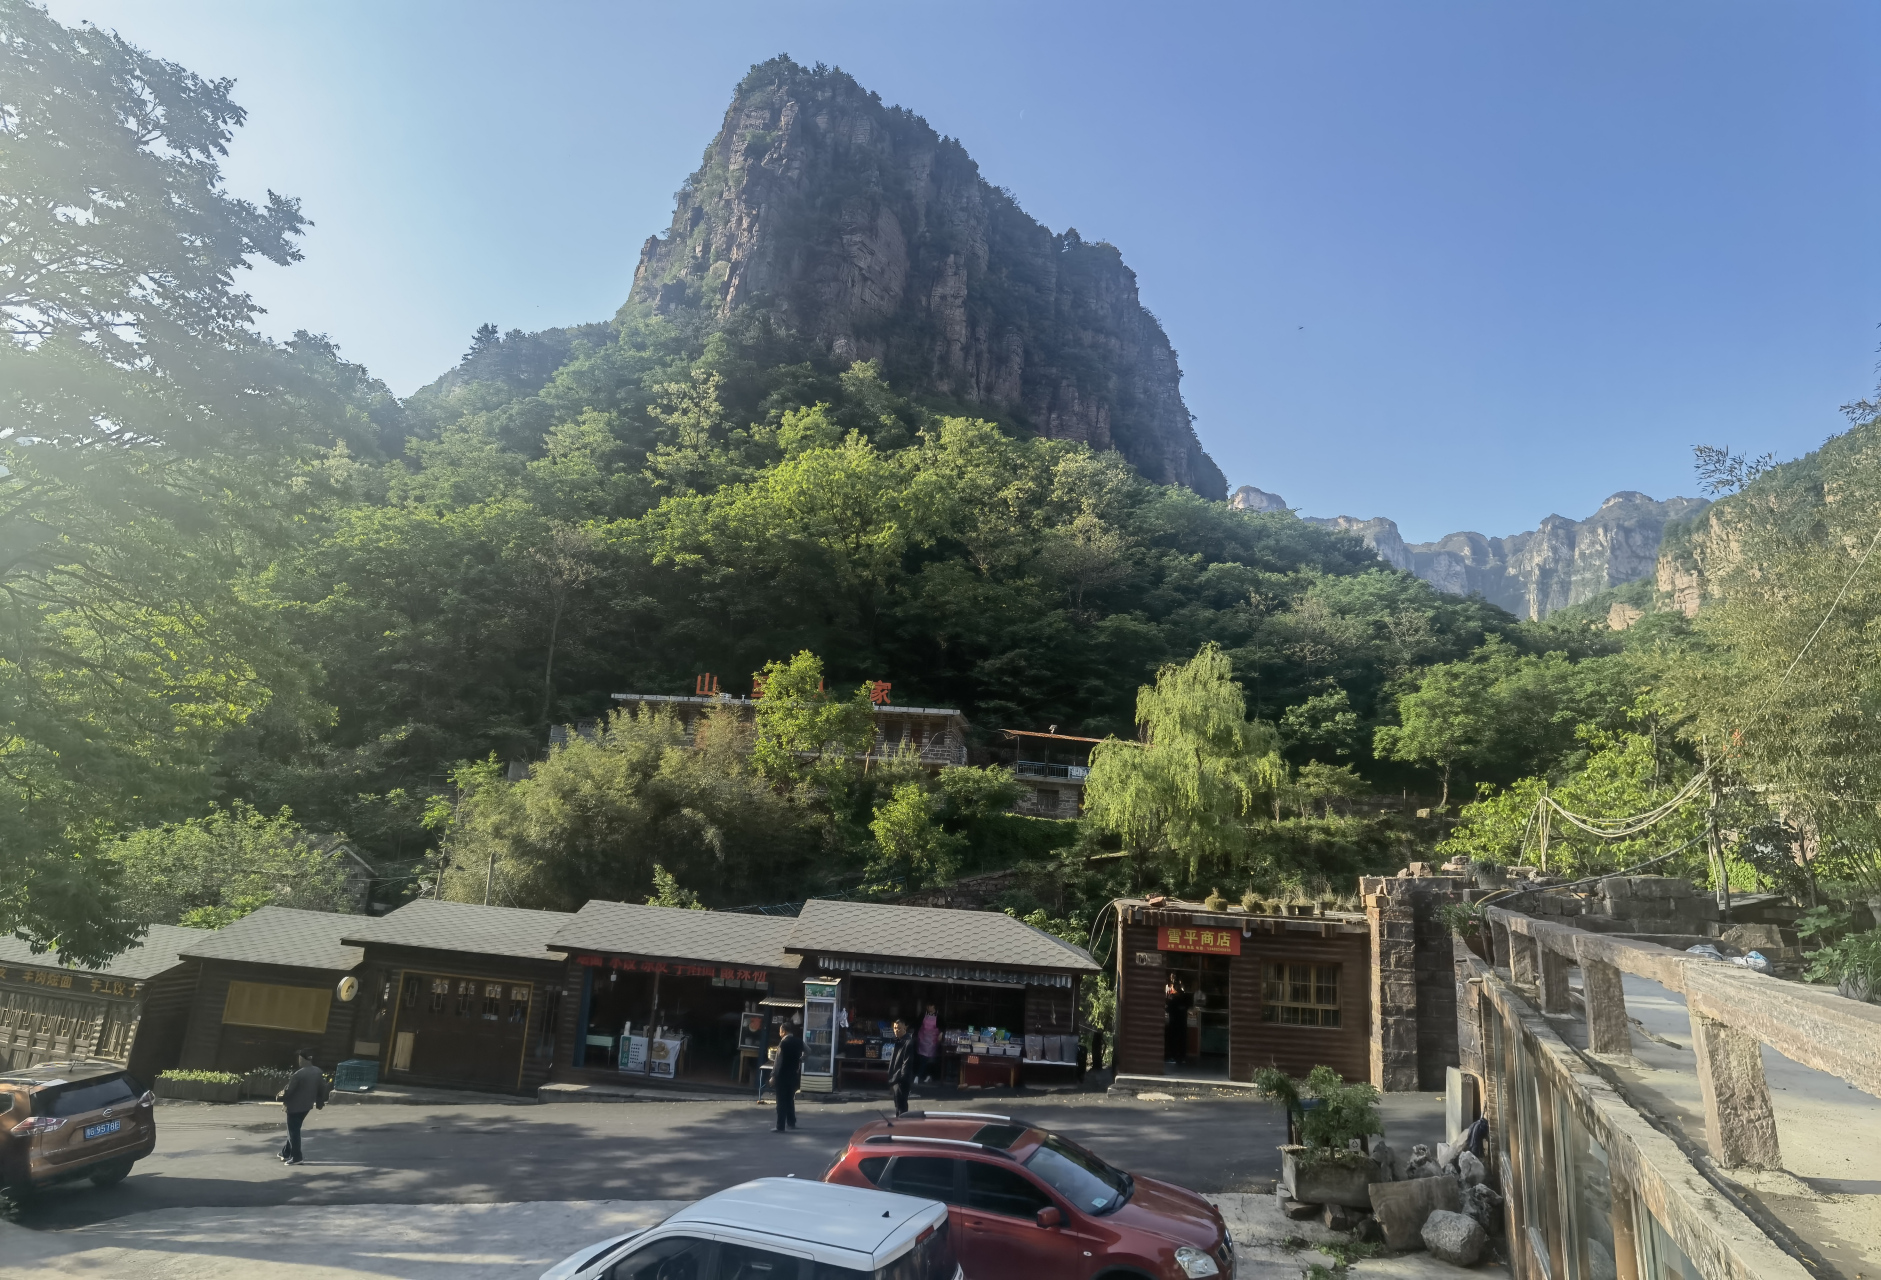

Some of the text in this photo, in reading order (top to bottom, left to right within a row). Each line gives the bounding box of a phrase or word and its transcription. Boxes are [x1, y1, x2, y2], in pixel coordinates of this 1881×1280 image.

[696, 672, 892, 704] 山家
[1167, 928, 1231, 947] 雪平商店
[90, 979, 138, 998] 手工饺子
